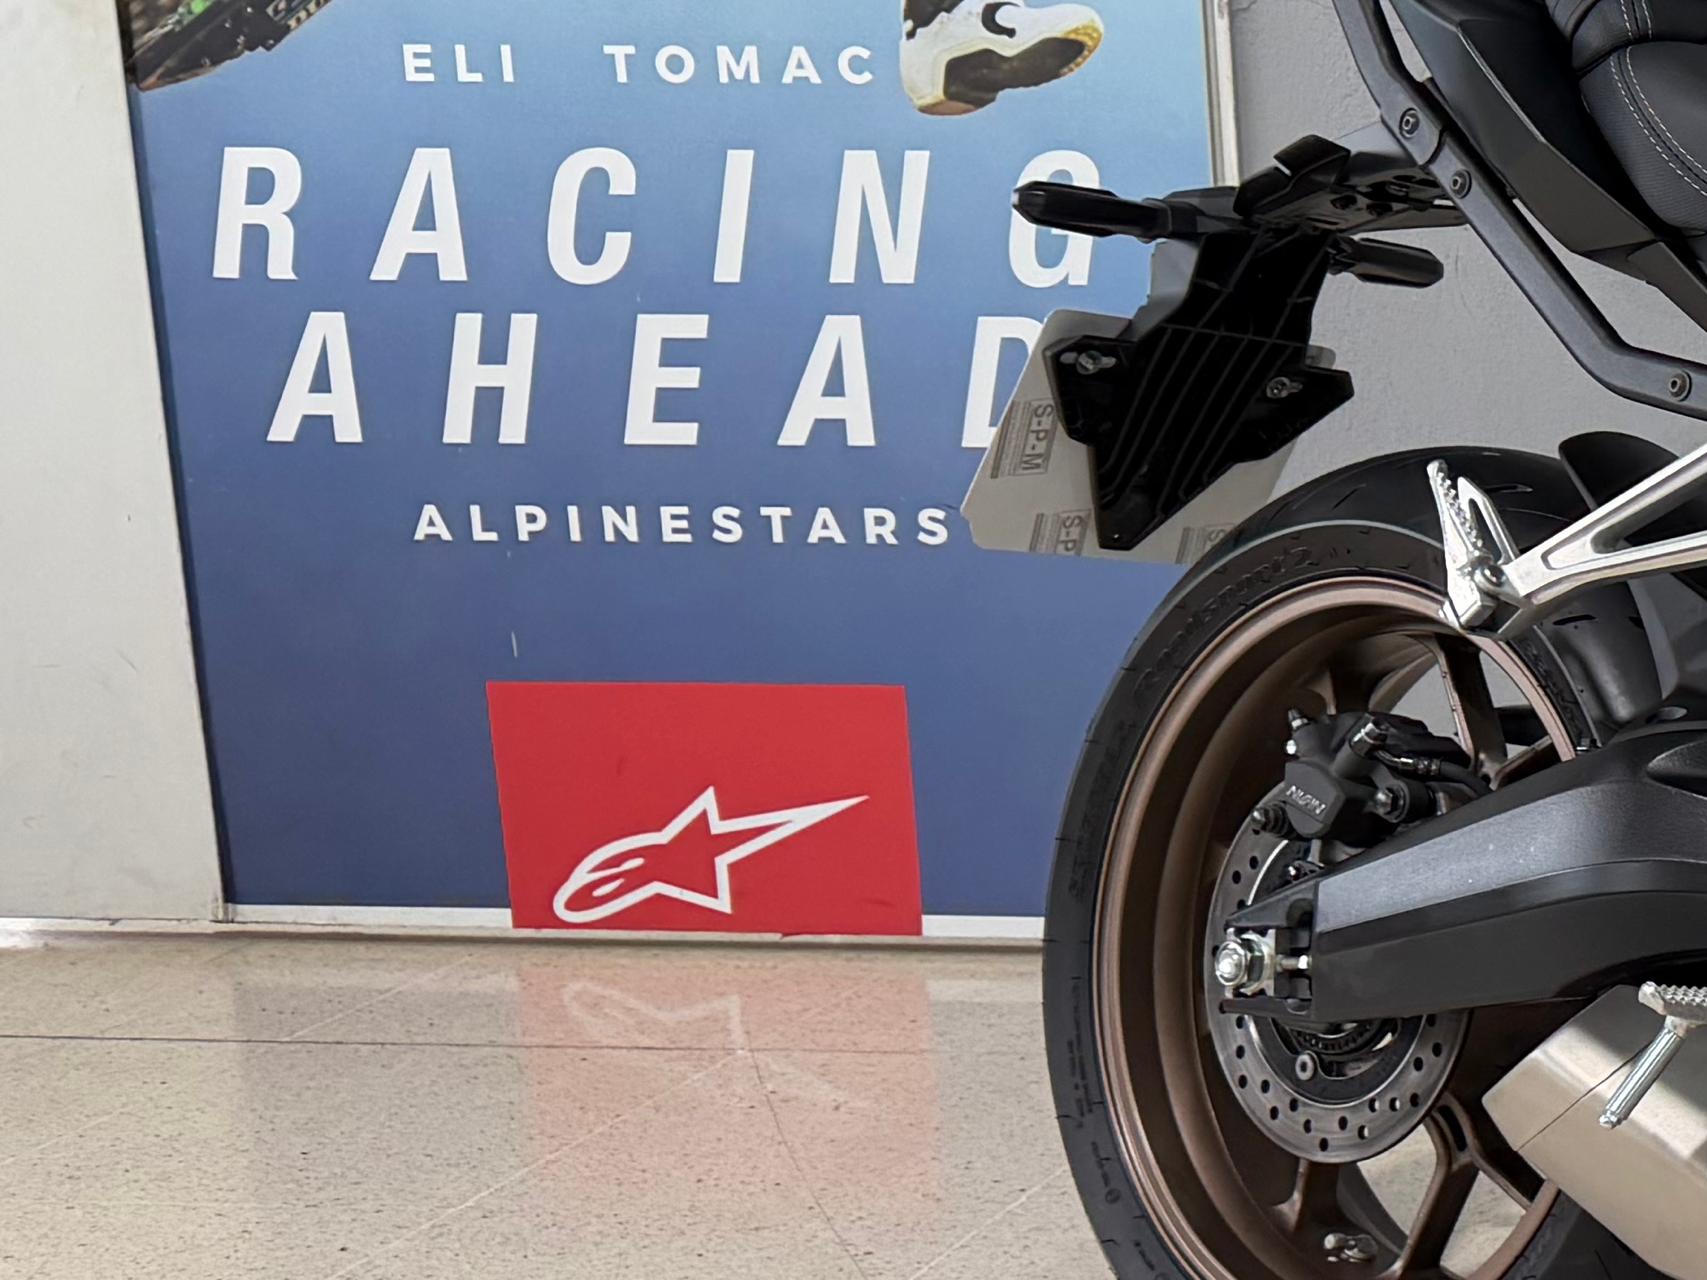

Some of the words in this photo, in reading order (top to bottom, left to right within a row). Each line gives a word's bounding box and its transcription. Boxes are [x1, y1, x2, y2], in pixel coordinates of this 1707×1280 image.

[402, 44, 515, 85] ELI
[604, 44, 875, 86] TOMAC
[211, 145, 1103, 288] RACING
[413, 503, 951, 546] ALPINESTARS
